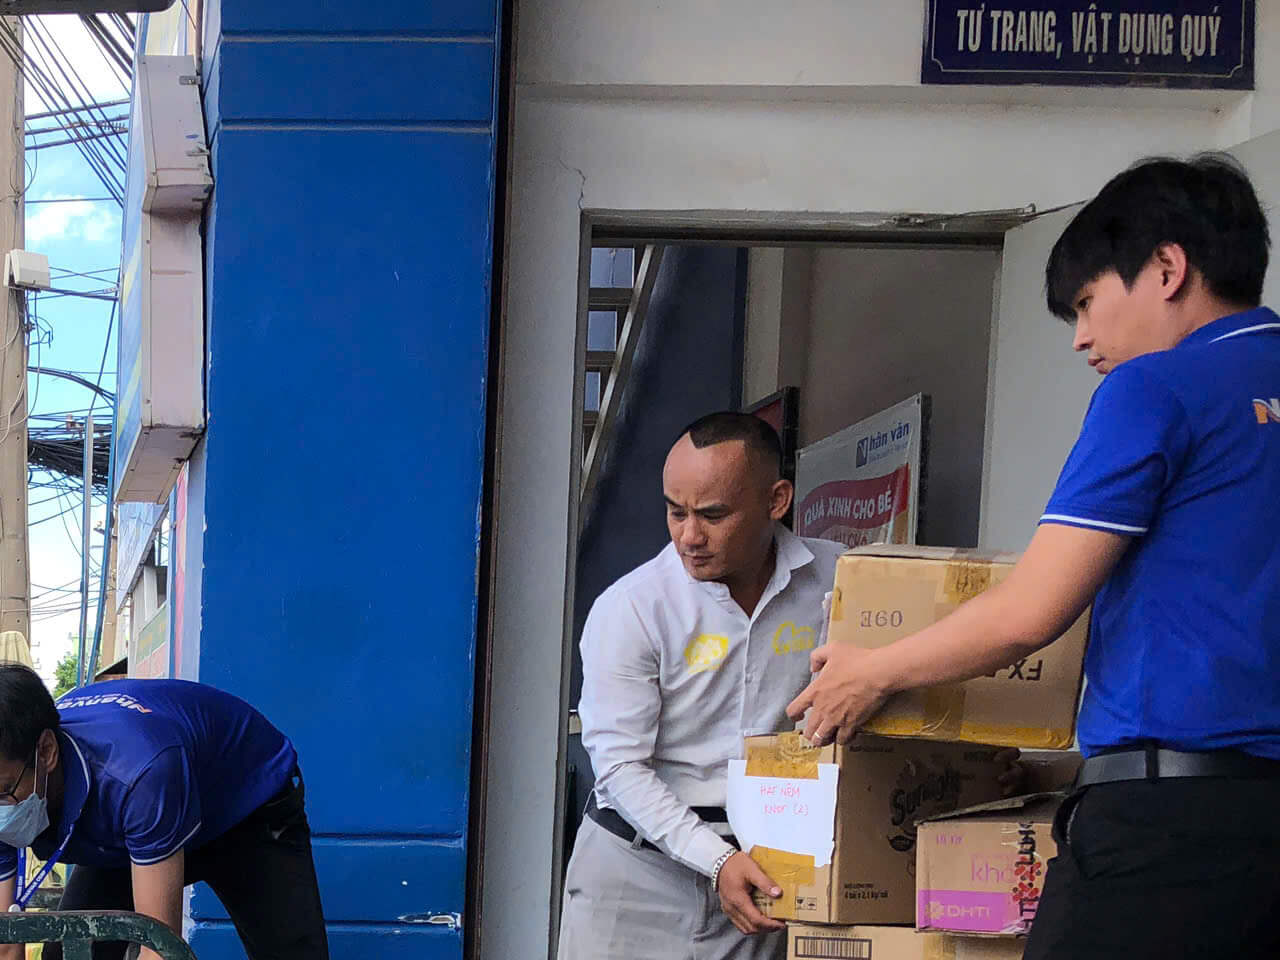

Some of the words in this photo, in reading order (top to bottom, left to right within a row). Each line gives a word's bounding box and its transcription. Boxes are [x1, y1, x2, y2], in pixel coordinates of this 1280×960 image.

[957, 3, 985, 52] TƯ
[990, 10, 1063, 60] TRANG,
[1072, 3, 1112, 64] VẬT
[1119, 13, 1174, 64] DỤNG
[1180, 5, 1221, 62] QUÝ
[827, 496, 851, 519] XINH
[853, 498, 875, 520] CHO
[878, 484, 892, 515] BÉ
